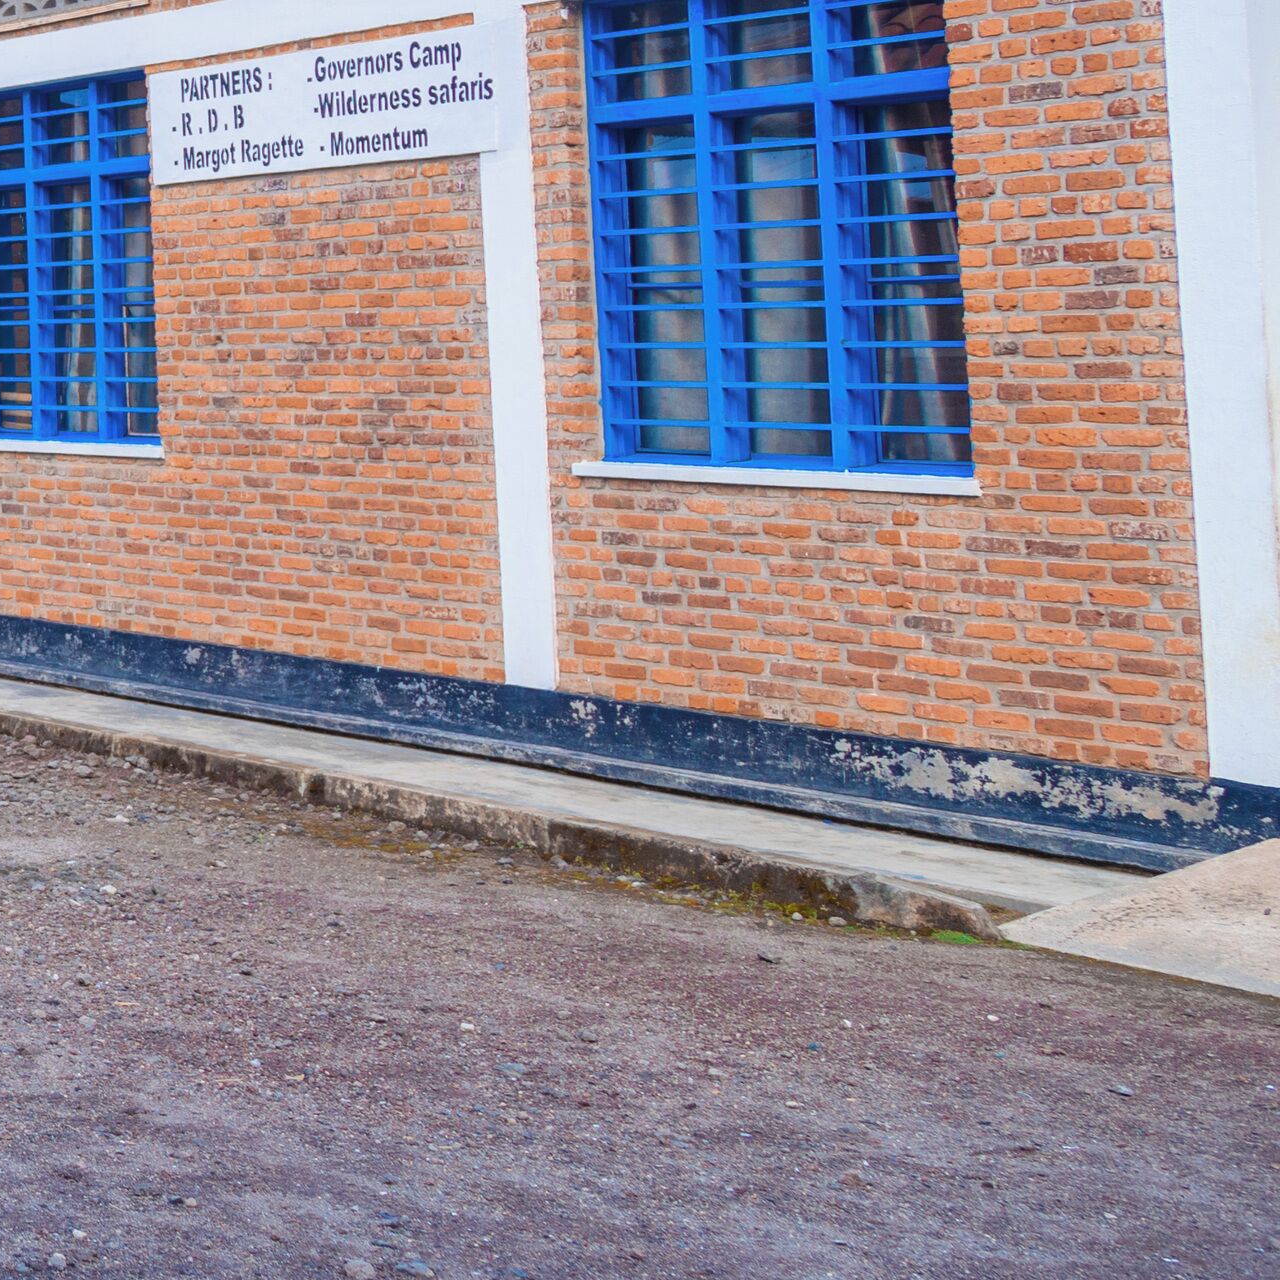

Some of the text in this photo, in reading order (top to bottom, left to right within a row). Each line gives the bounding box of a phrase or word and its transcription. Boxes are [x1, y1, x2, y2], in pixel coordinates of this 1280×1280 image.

[409, 41, 462, 70] Camp
[428, 72, 493, 106] safaris
[183, 141, 236, 172] Margot
[241, 134, 304, 167] Ragette
[330, 126, 428, 157] Momentum
